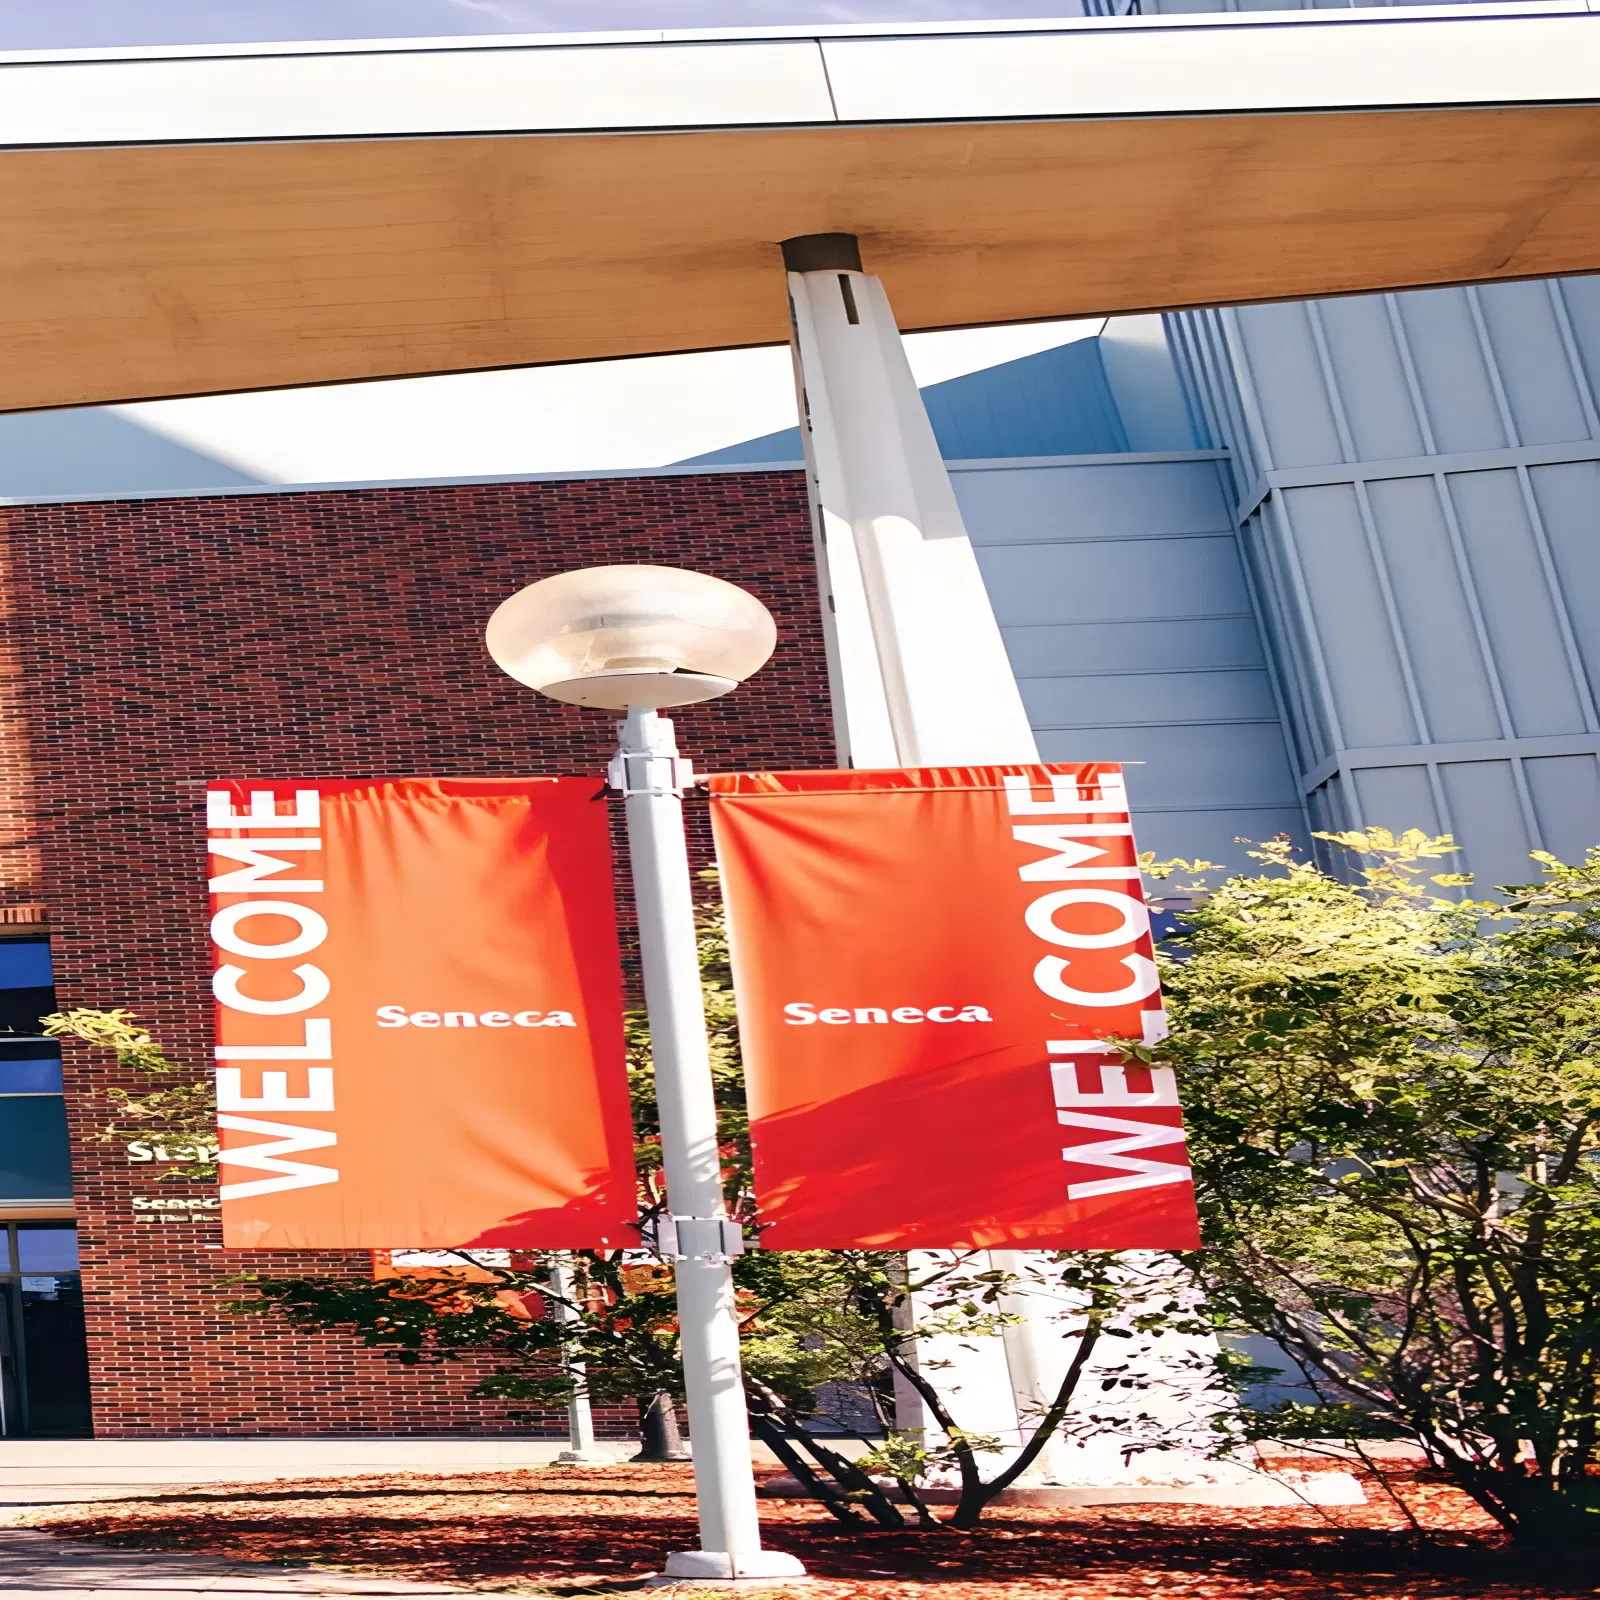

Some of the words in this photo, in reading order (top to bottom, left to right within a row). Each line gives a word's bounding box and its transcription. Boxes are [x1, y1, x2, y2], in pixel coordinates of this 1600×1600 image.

[206, 789, 340, 1201] WELCOME
[375, 1005, 578, 1028] Seneca
[783, 1002, 994, 1026] Seneca
[1002, 772, 1193, 1201] WELCOME
